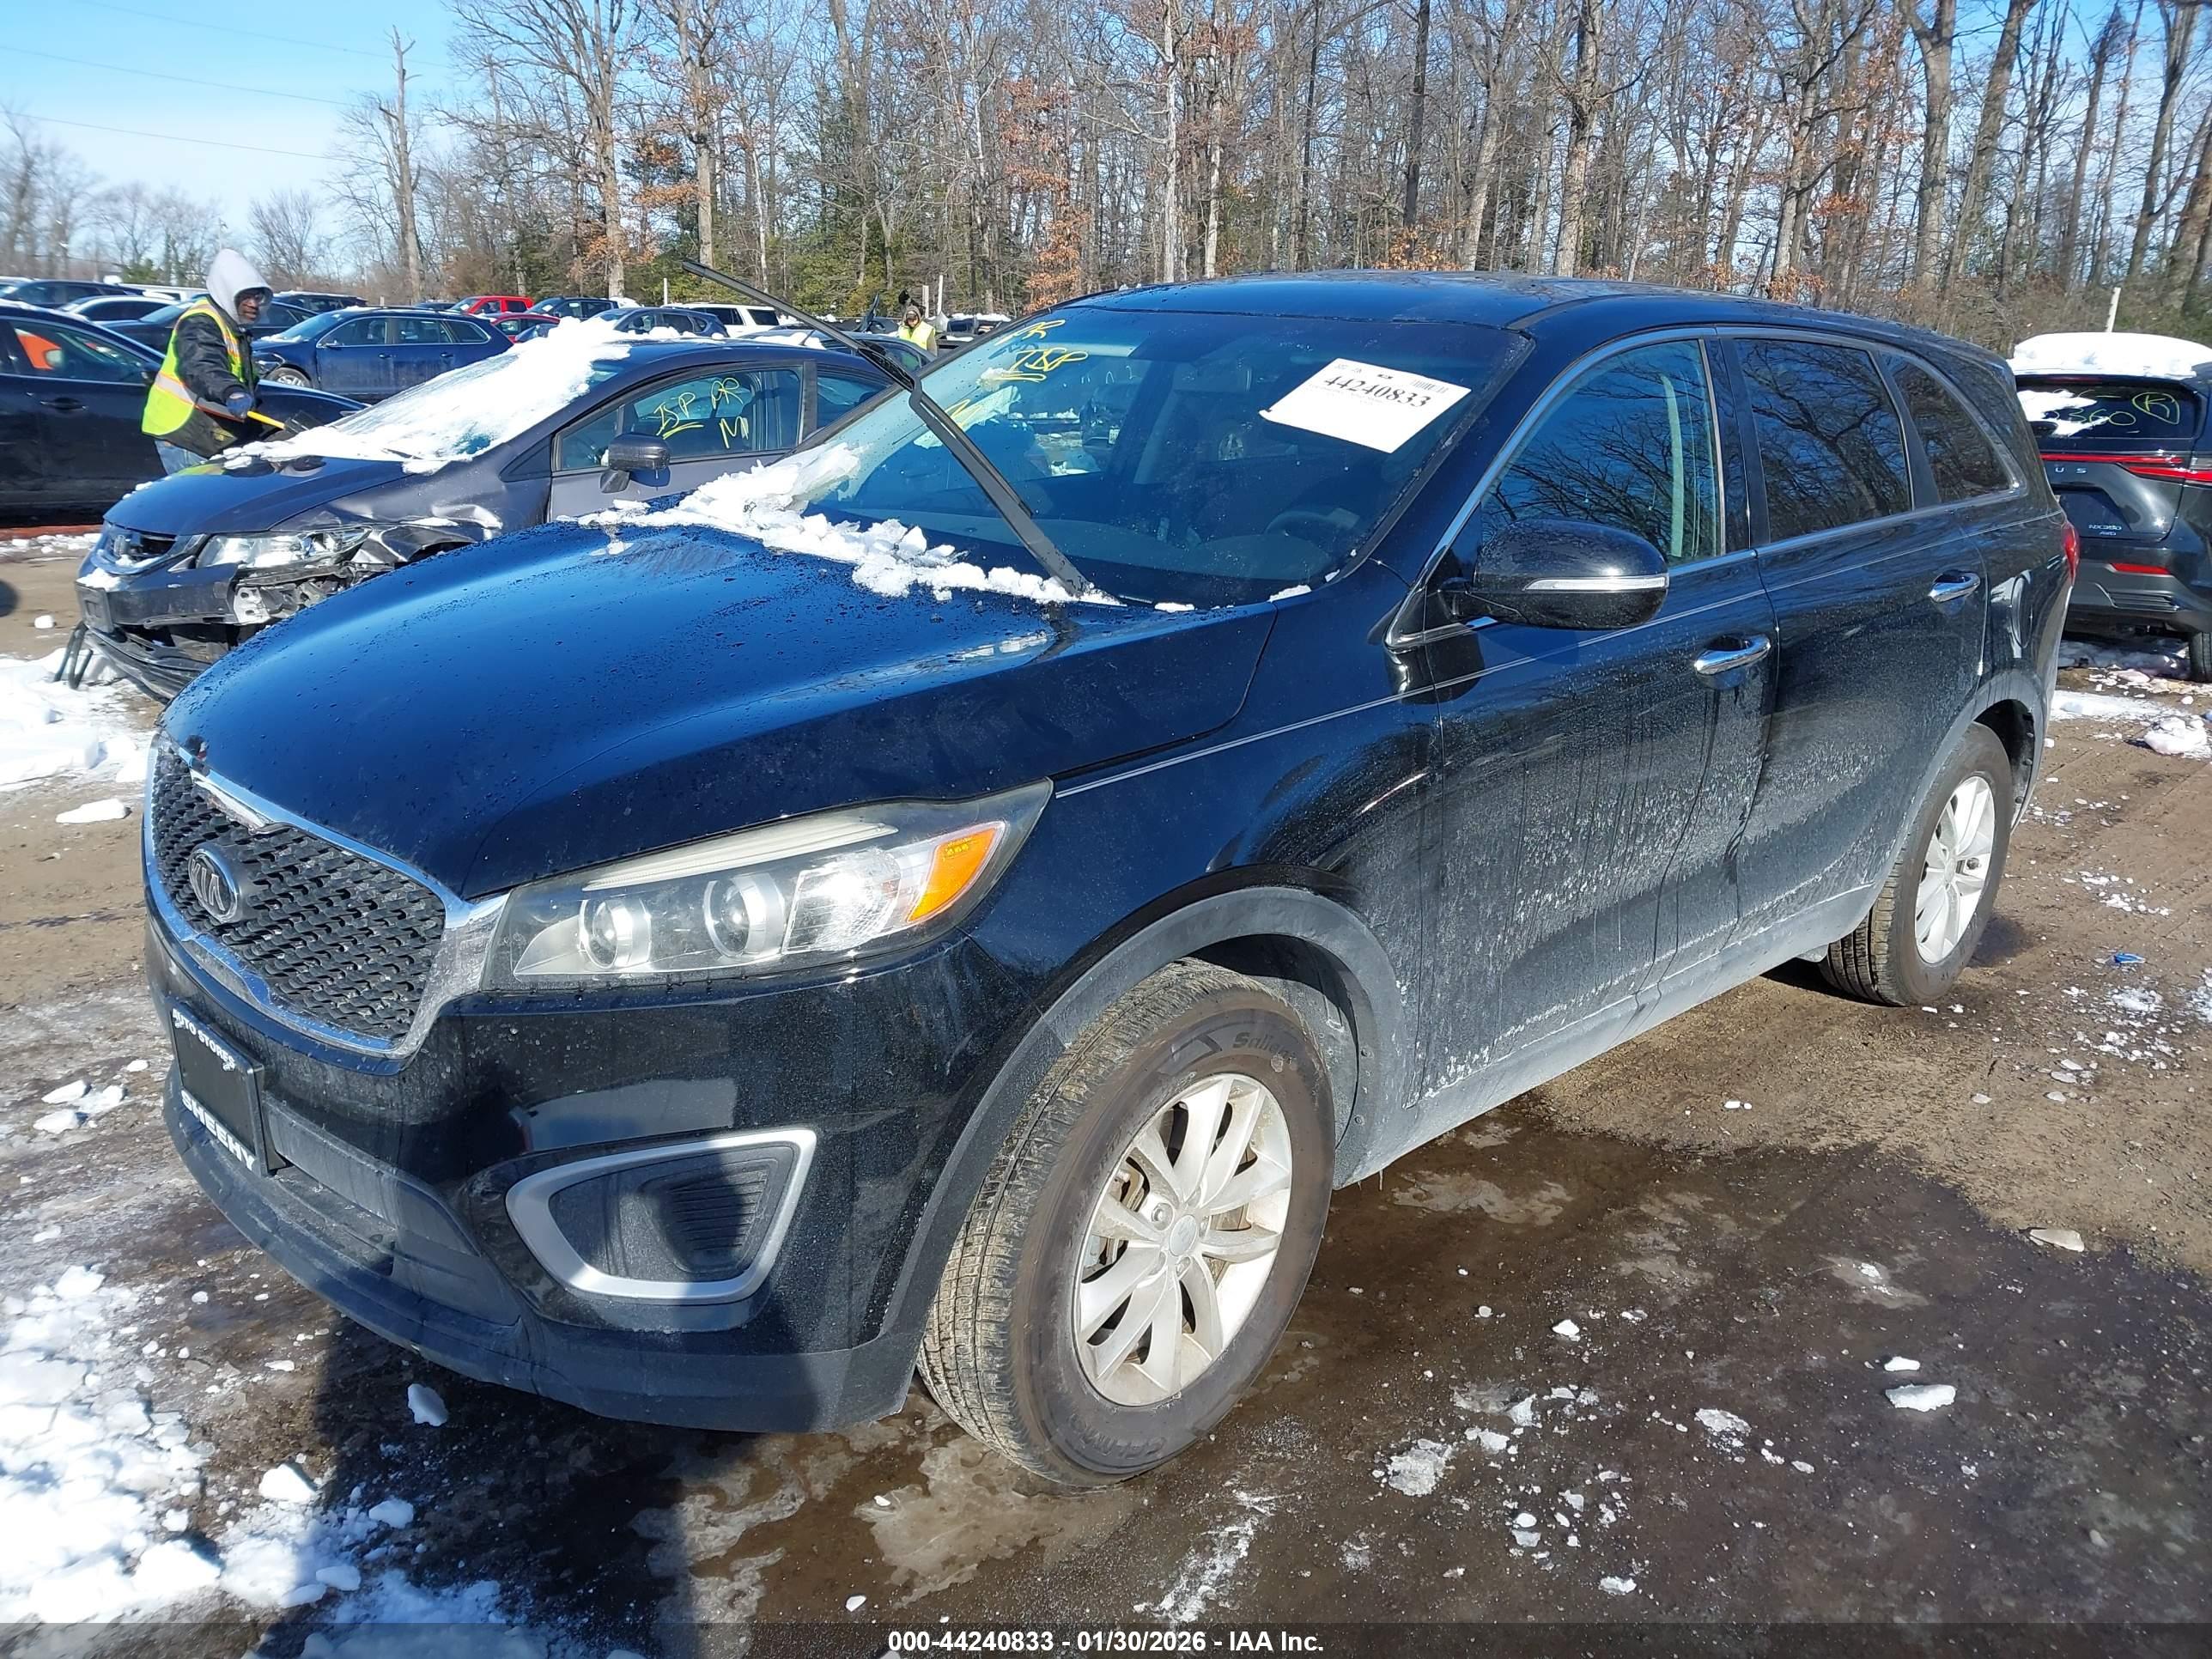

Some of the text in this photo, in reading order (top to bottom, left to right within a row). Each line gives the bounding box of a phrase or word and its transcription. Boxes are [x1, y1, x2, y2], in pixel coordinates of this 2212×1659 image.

[1323, 374, 1432, 408] 44240833
[172, 1008, 236, 1071] AUTO STORES
[180, 1089, 256, 1172] SHEEHY
